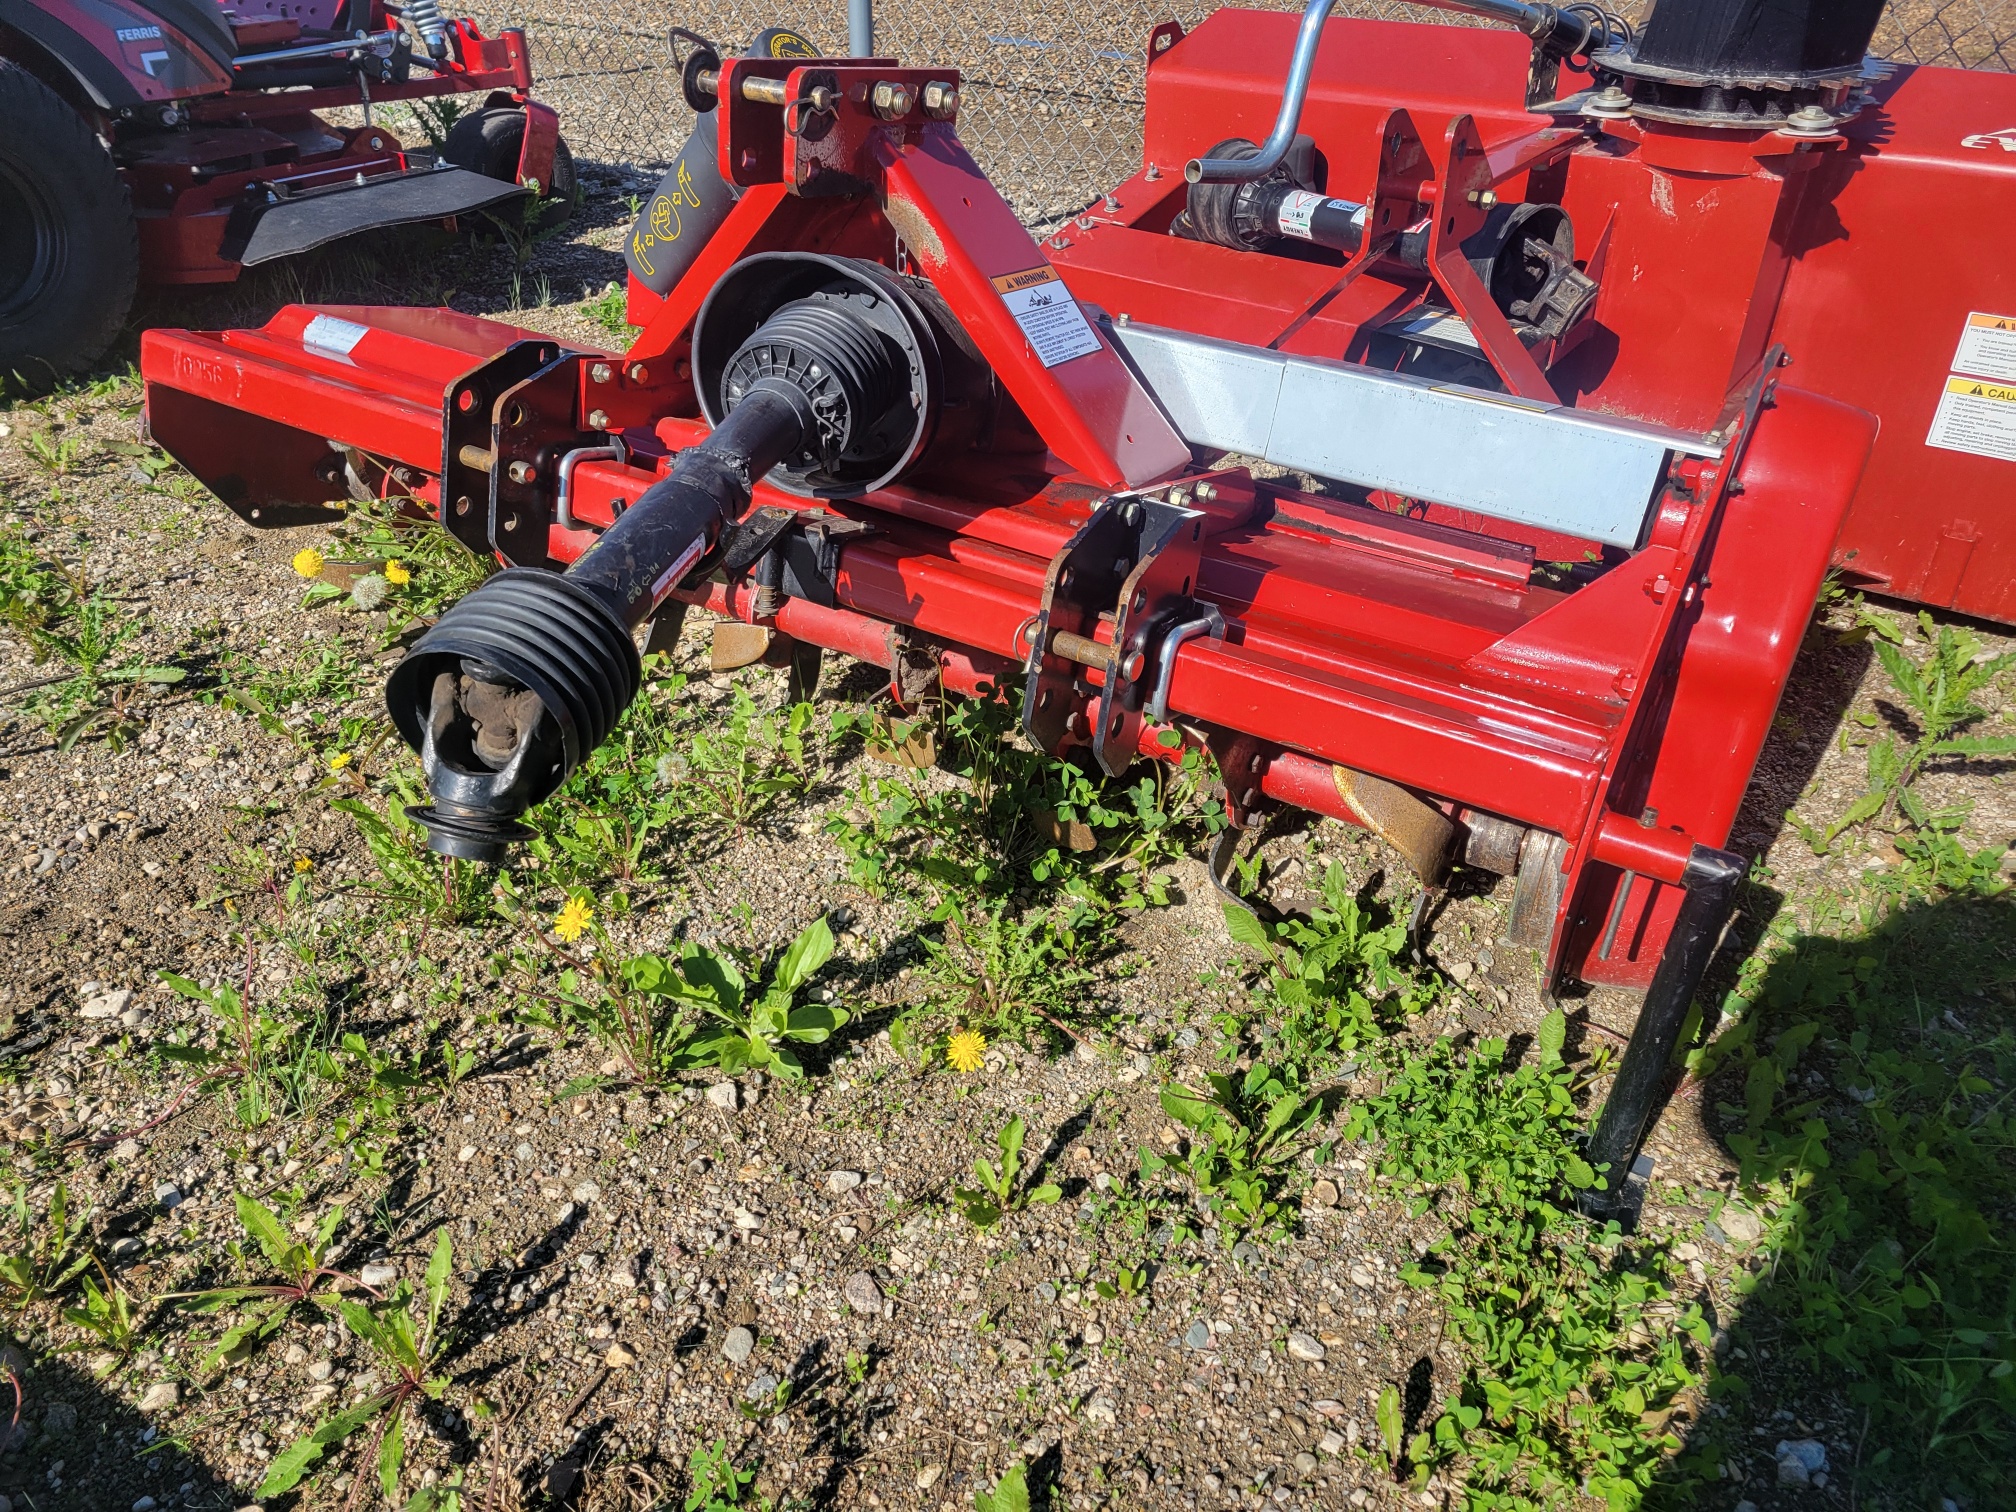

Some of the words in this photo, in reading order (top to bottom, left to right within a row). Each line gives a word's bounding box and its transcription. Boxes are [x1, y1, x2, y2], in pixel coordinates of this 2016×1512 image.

[116, 26, 160, 41] FERRIS
[1012, 270, 1050, 287] WARNING
[1988, 388, 2016, 402] CAU
